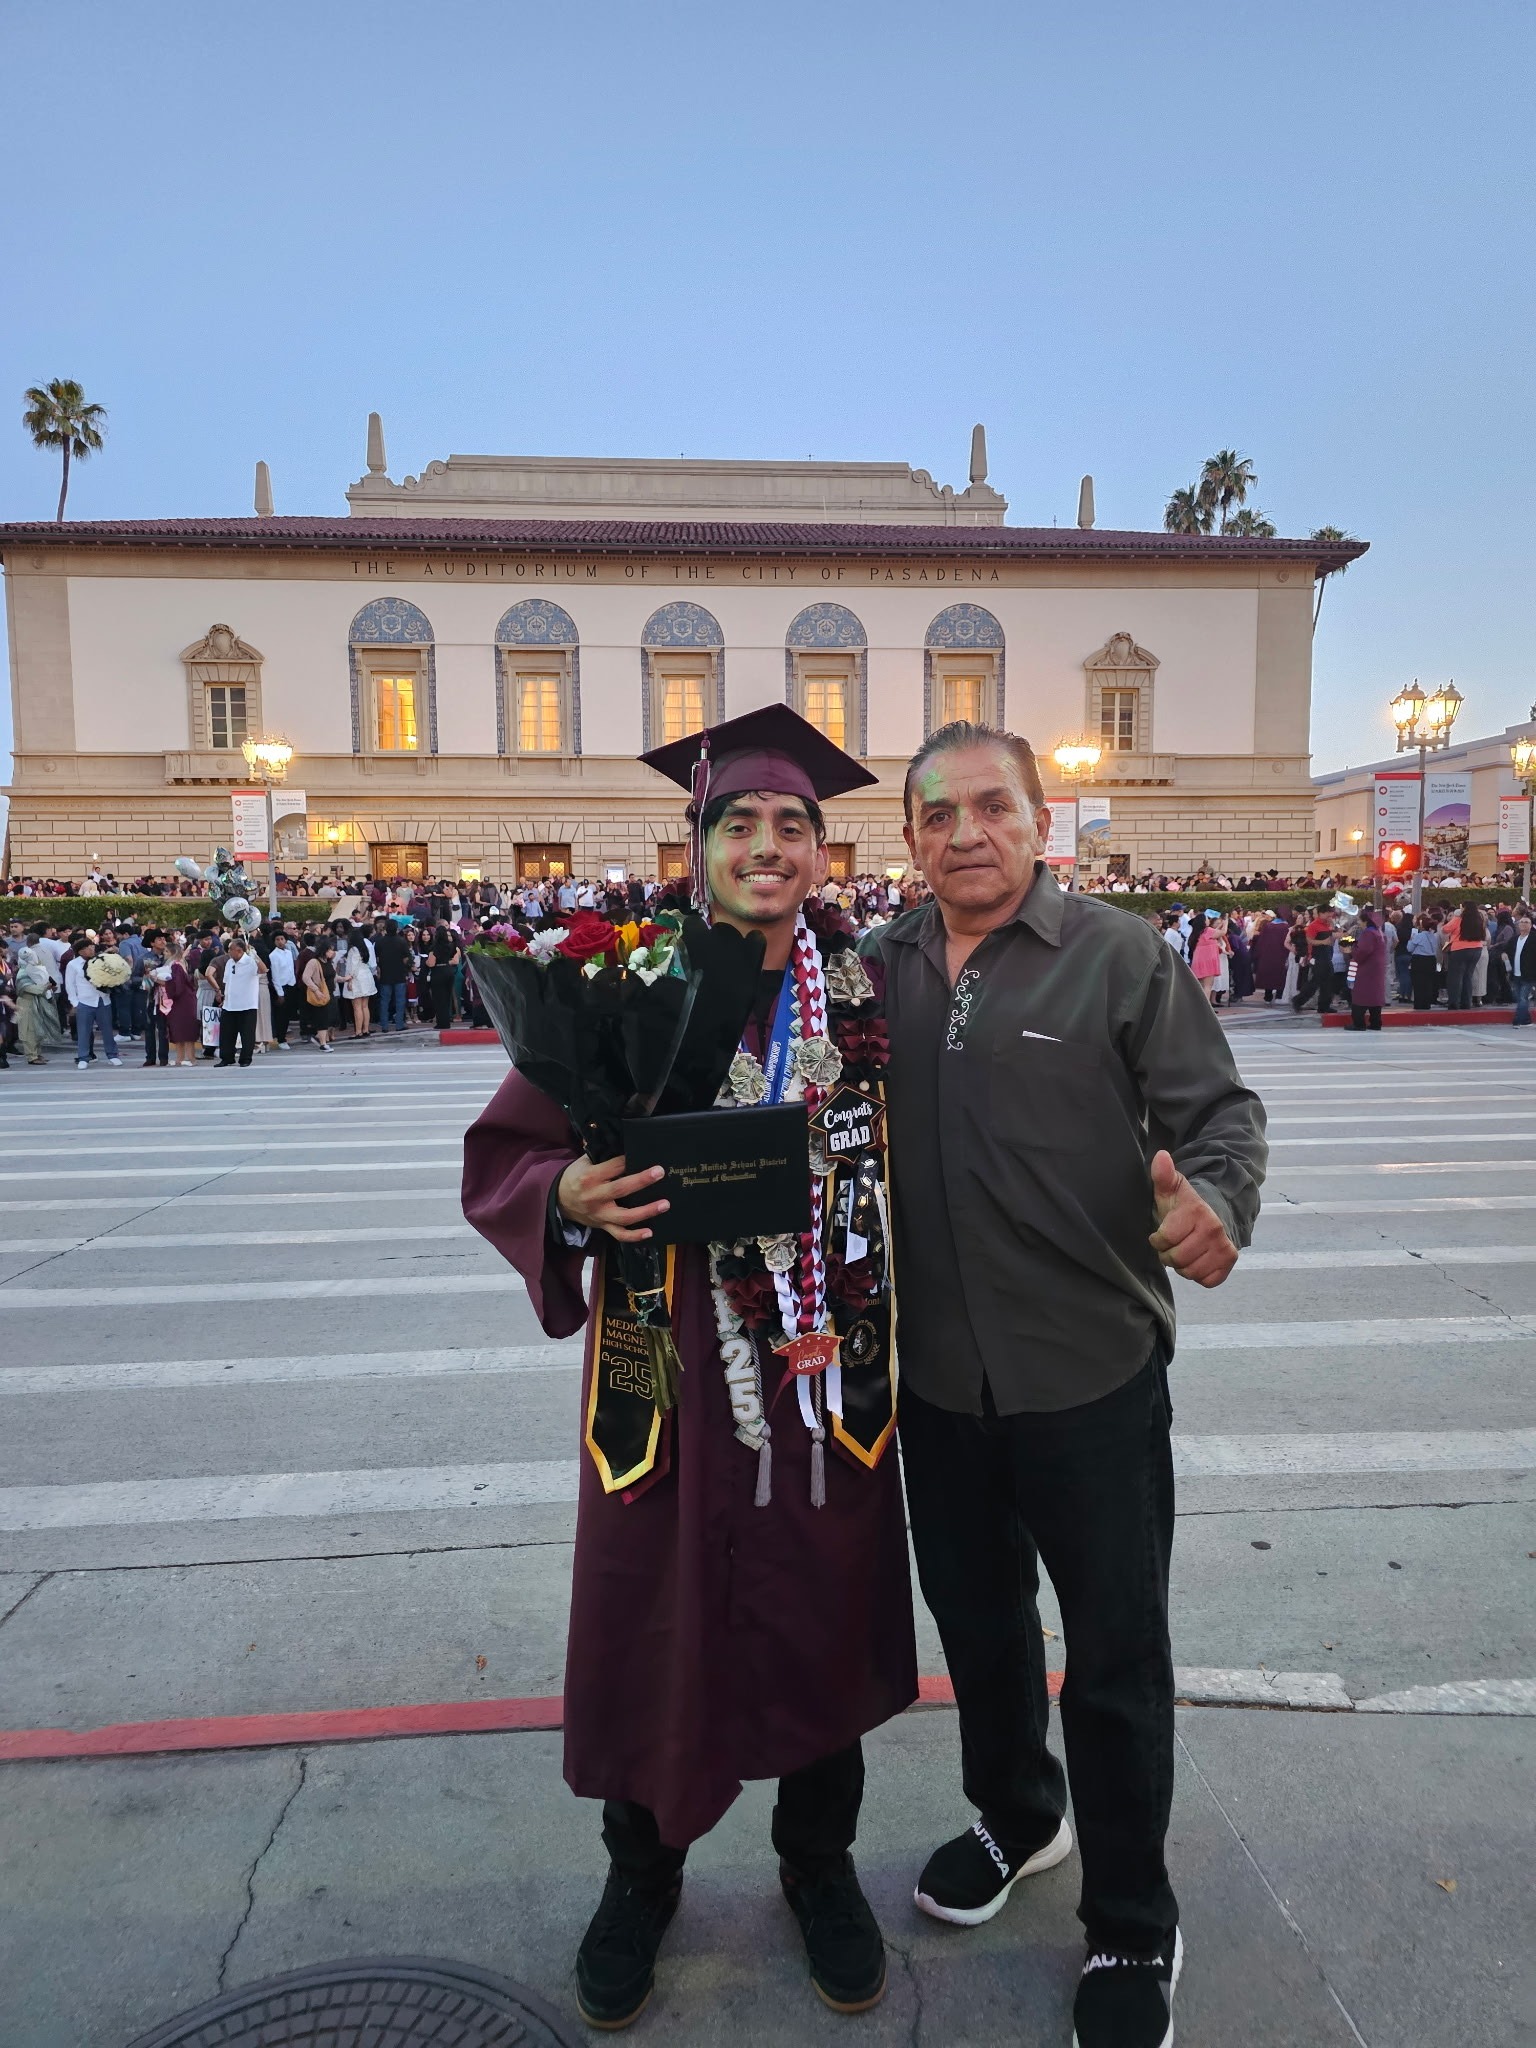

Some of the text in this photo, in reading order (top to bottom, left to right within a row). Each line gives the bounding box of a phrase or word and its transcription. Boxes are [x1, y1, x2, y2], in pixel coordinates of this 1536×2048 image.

[351, 561, 1000, 581] THE AUDITORIUM OF THE CITY OF PASADENA
[823, 1101, 873, 1129] Congrats
[829, 1125, 871, 1152] GRAD
[700, 1163, 728, 1173] Unified
[730, 1160, 756, 1171] School
[759, 1157, 787, 1169] District
[712, 1174, 719, 1183] of
[606, 1317, 644, 1335] MEDIC
[602, 1338, 649, 1356] HIGH SCHO
[797, 1355, 826, 1370] GRAD
[1081, 1952, 1165, 1975] NAUA
